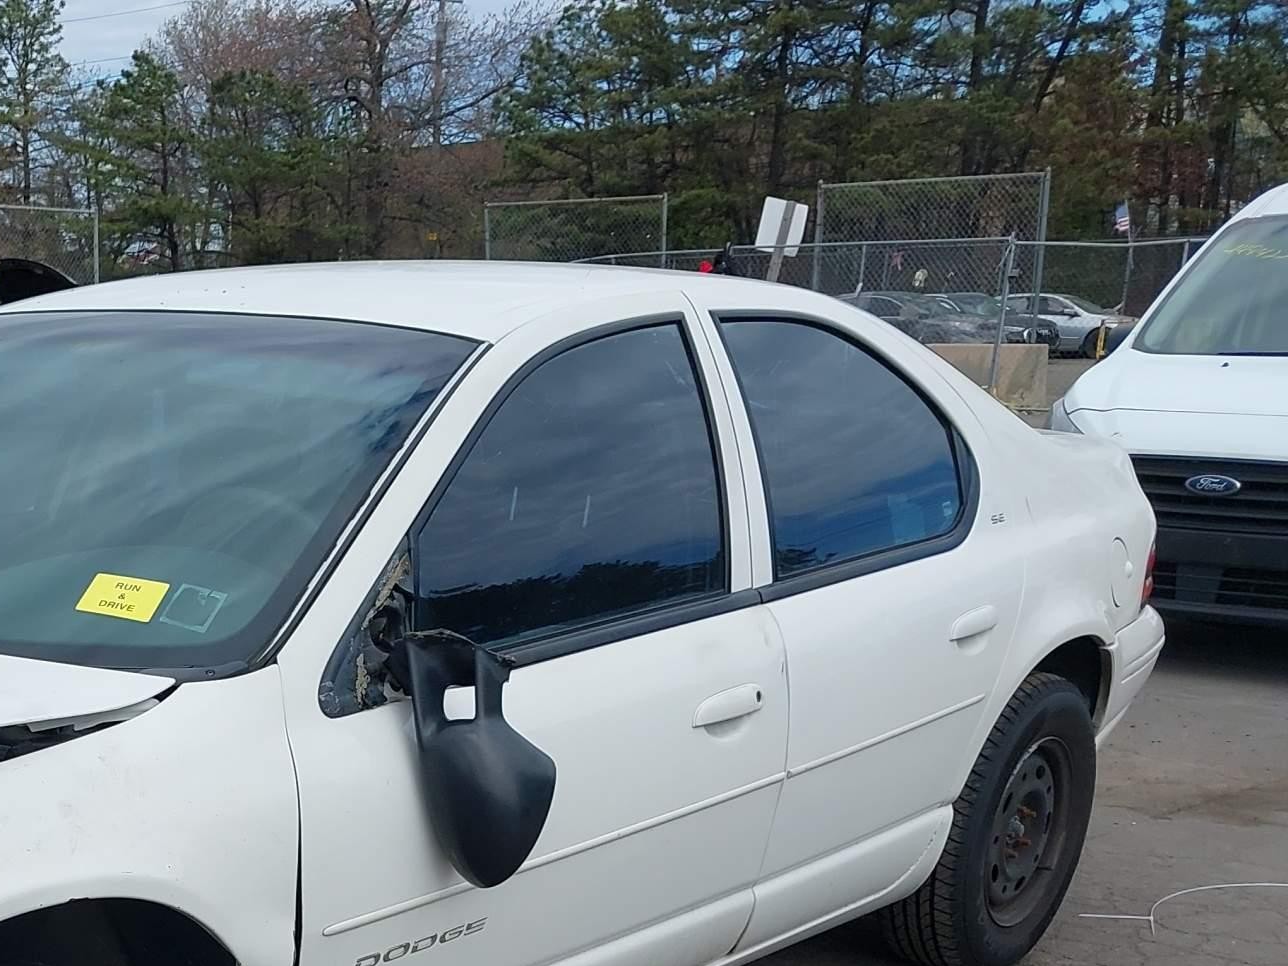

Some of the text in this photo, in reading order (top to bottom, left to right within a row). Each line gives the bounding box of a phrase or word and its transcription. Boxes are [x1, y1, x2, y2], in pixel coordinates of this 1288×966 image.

[1196, 478, 1227, 491] Ford
[991, 513, 1006, 524] SE
[115, 582, 142, 592] RUN
[117, 592, 126, 600] &
[98, 599, 136, 612] DRIVE
